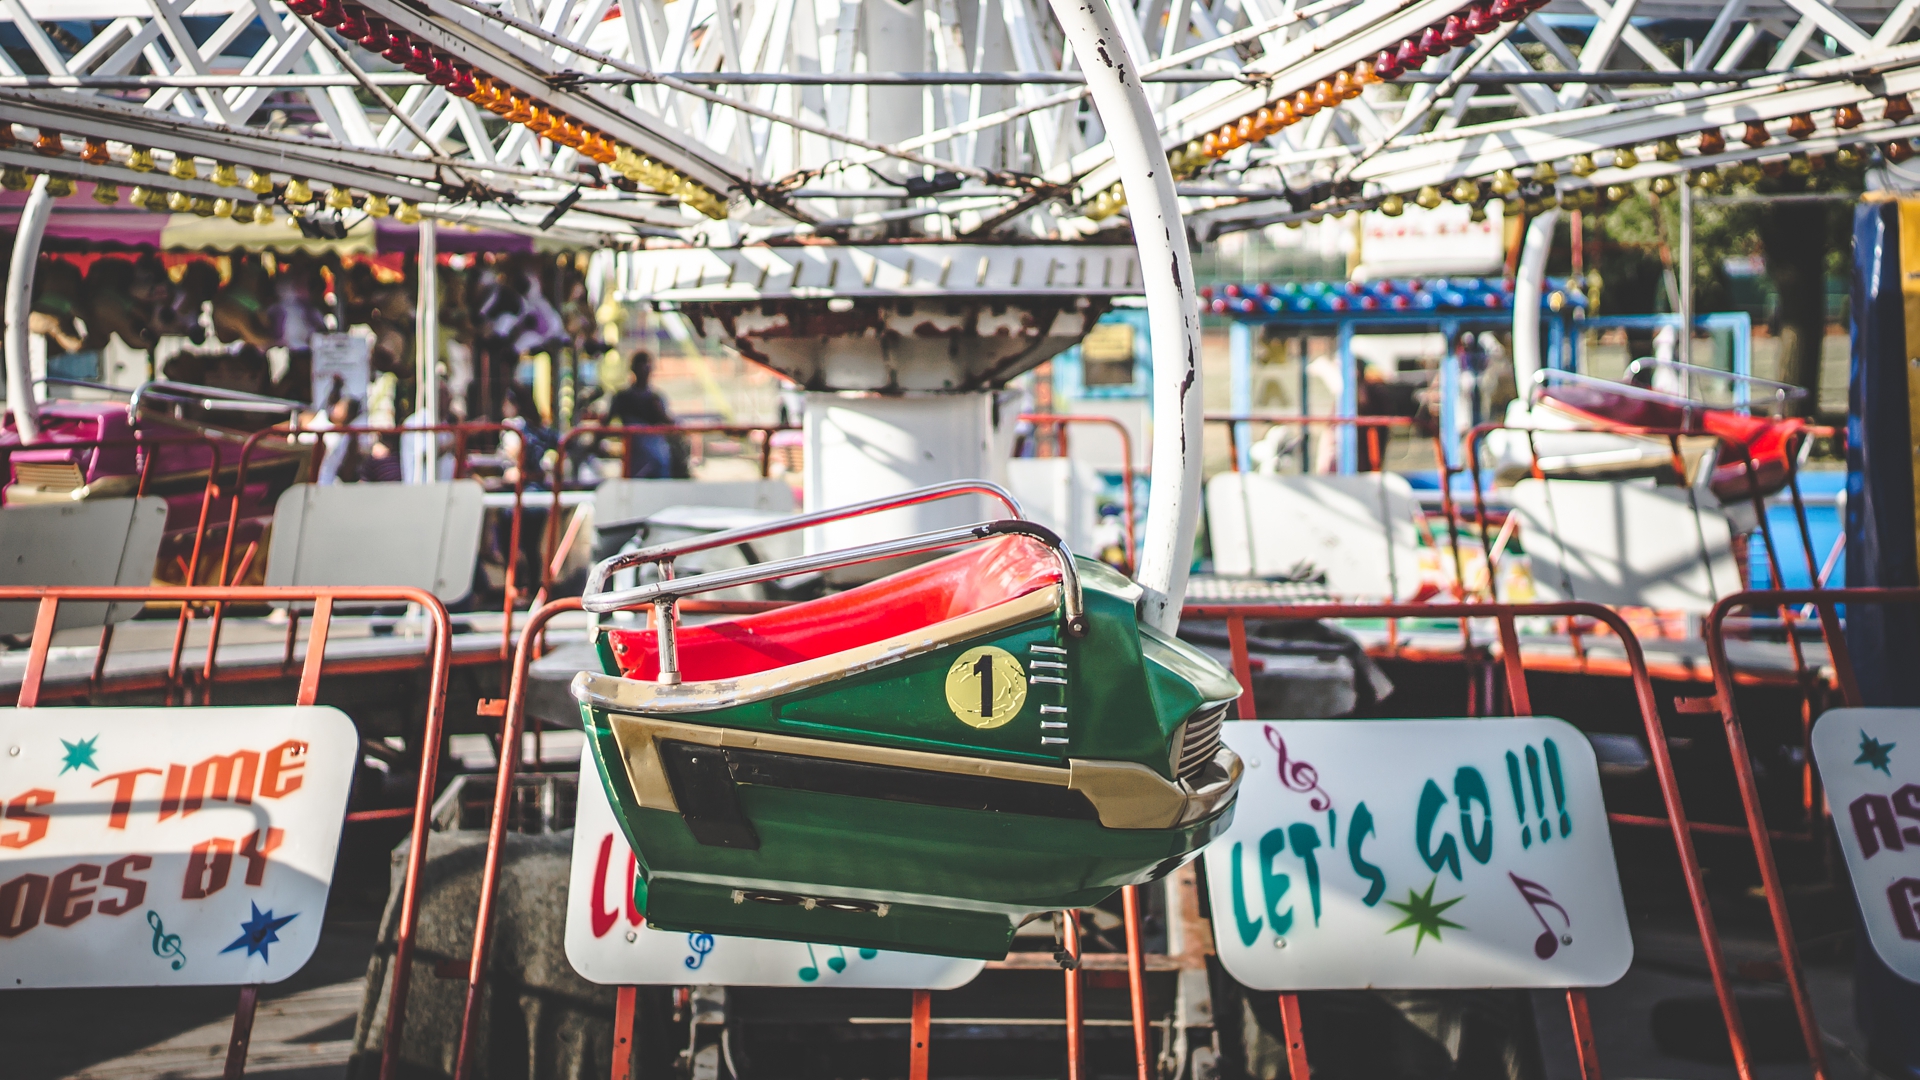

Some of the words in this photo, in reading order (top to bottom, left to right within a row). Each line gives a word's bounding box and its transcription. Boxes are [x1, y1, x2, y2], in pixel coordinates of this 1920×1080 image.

[973, 654, 993, 717] 1
[0, 786, 56, 849] S
[91, 739, 309, 830] TIME
[181, 826, 285, 901] BY
[1231, 800, 1387, 948] LET'S
